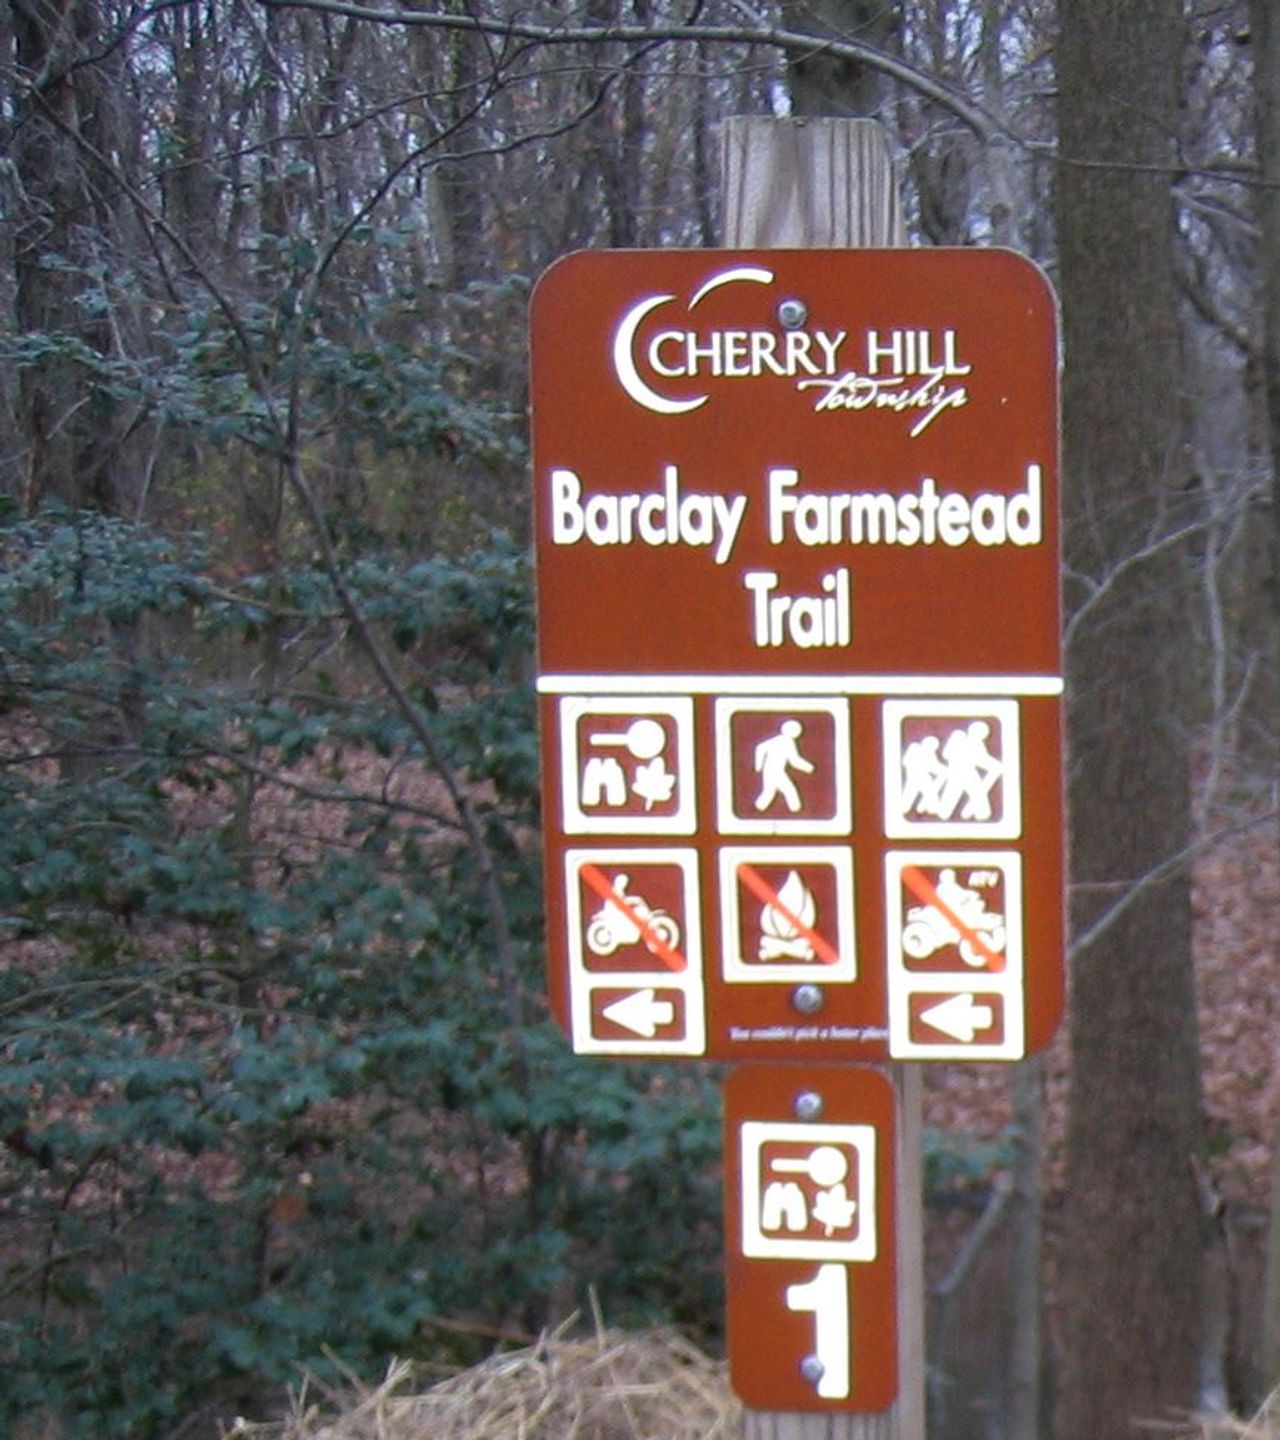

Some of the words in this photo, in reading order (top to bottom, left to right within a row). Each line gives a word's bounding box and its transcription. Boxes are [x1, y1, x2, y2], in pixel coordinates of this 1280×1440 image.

[649, 330, 846, 377] CHERRY
[868, 330, 971, 376] HILL
[797, 370, 968, 438] Township
[551, 465, 746, 565] Barclay
[768, 464, 1043, 545] Farmstead
[744, 567, 851, 648] Trail
[786, 1263, 850, 1399] 1
